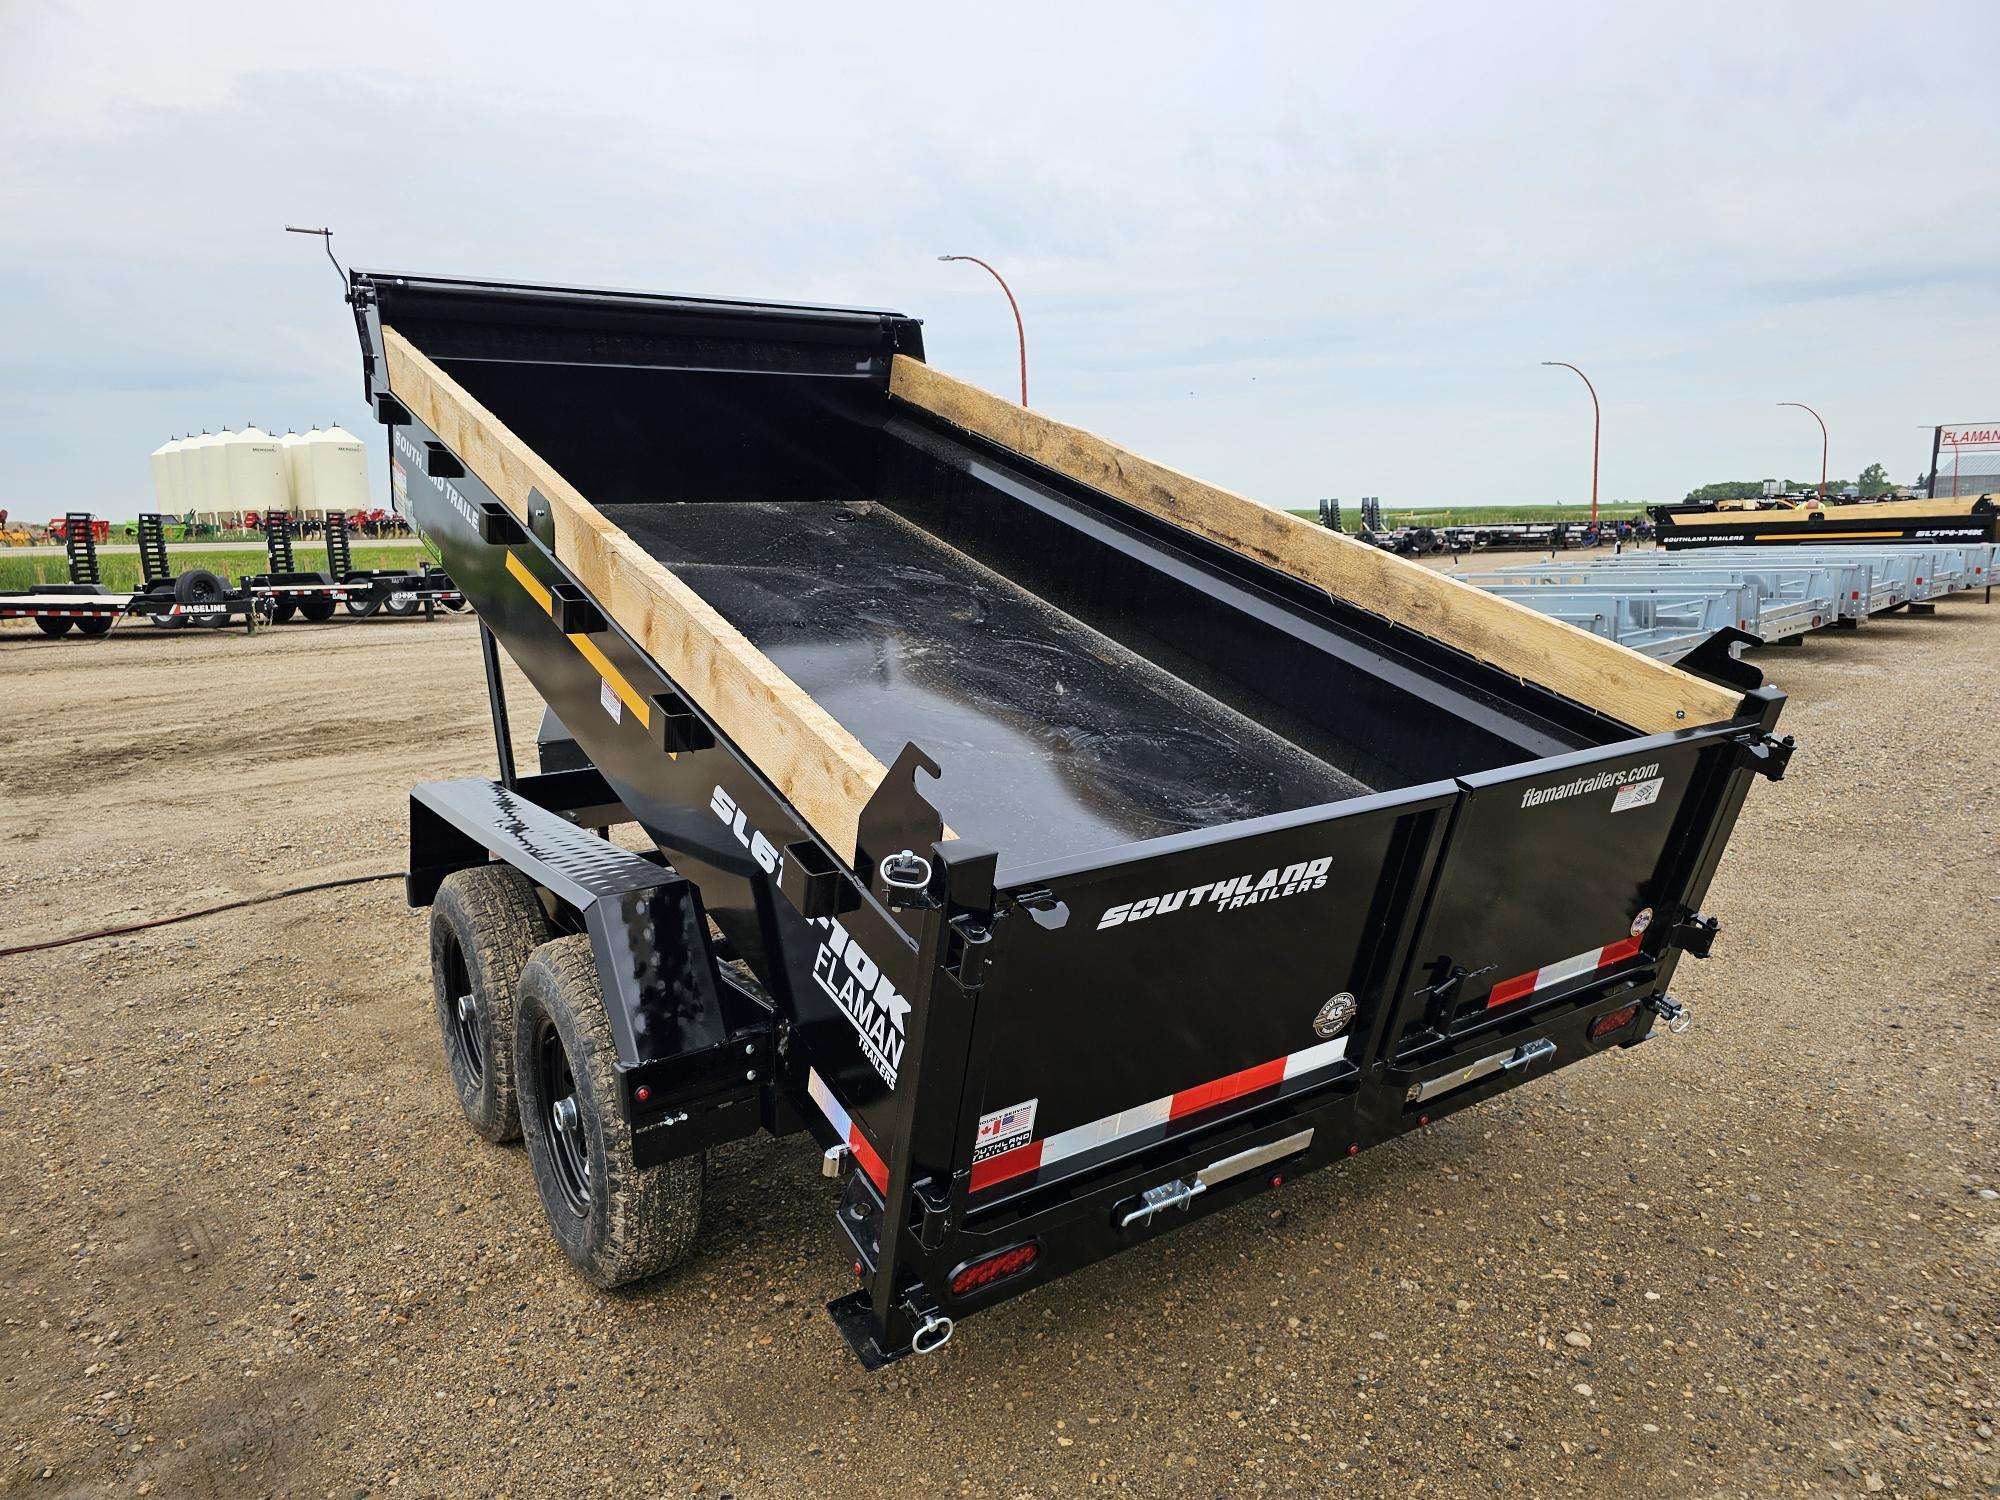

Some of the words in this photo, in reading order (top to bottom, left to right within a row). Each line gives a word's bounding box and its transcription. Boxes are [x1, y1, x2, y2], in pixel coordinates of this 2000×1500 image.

[1943, 430, 2000, 443] FLAMAN
[395, 431, 444, 492] SOUTHND
[446, 481, 480, 533] TRAILE
[180, 604, 227, 613] BASELINE
[1521, 761, 1660, 809] flamantrailers.com
[1096, 855, 1334, 931] SOUTHLAND
[1216, 874, 1329, 913] TRAILERS
[813, 941, 906, 1071] FLAMAN
[858, 1034, 897, 1091] TRAILERS
